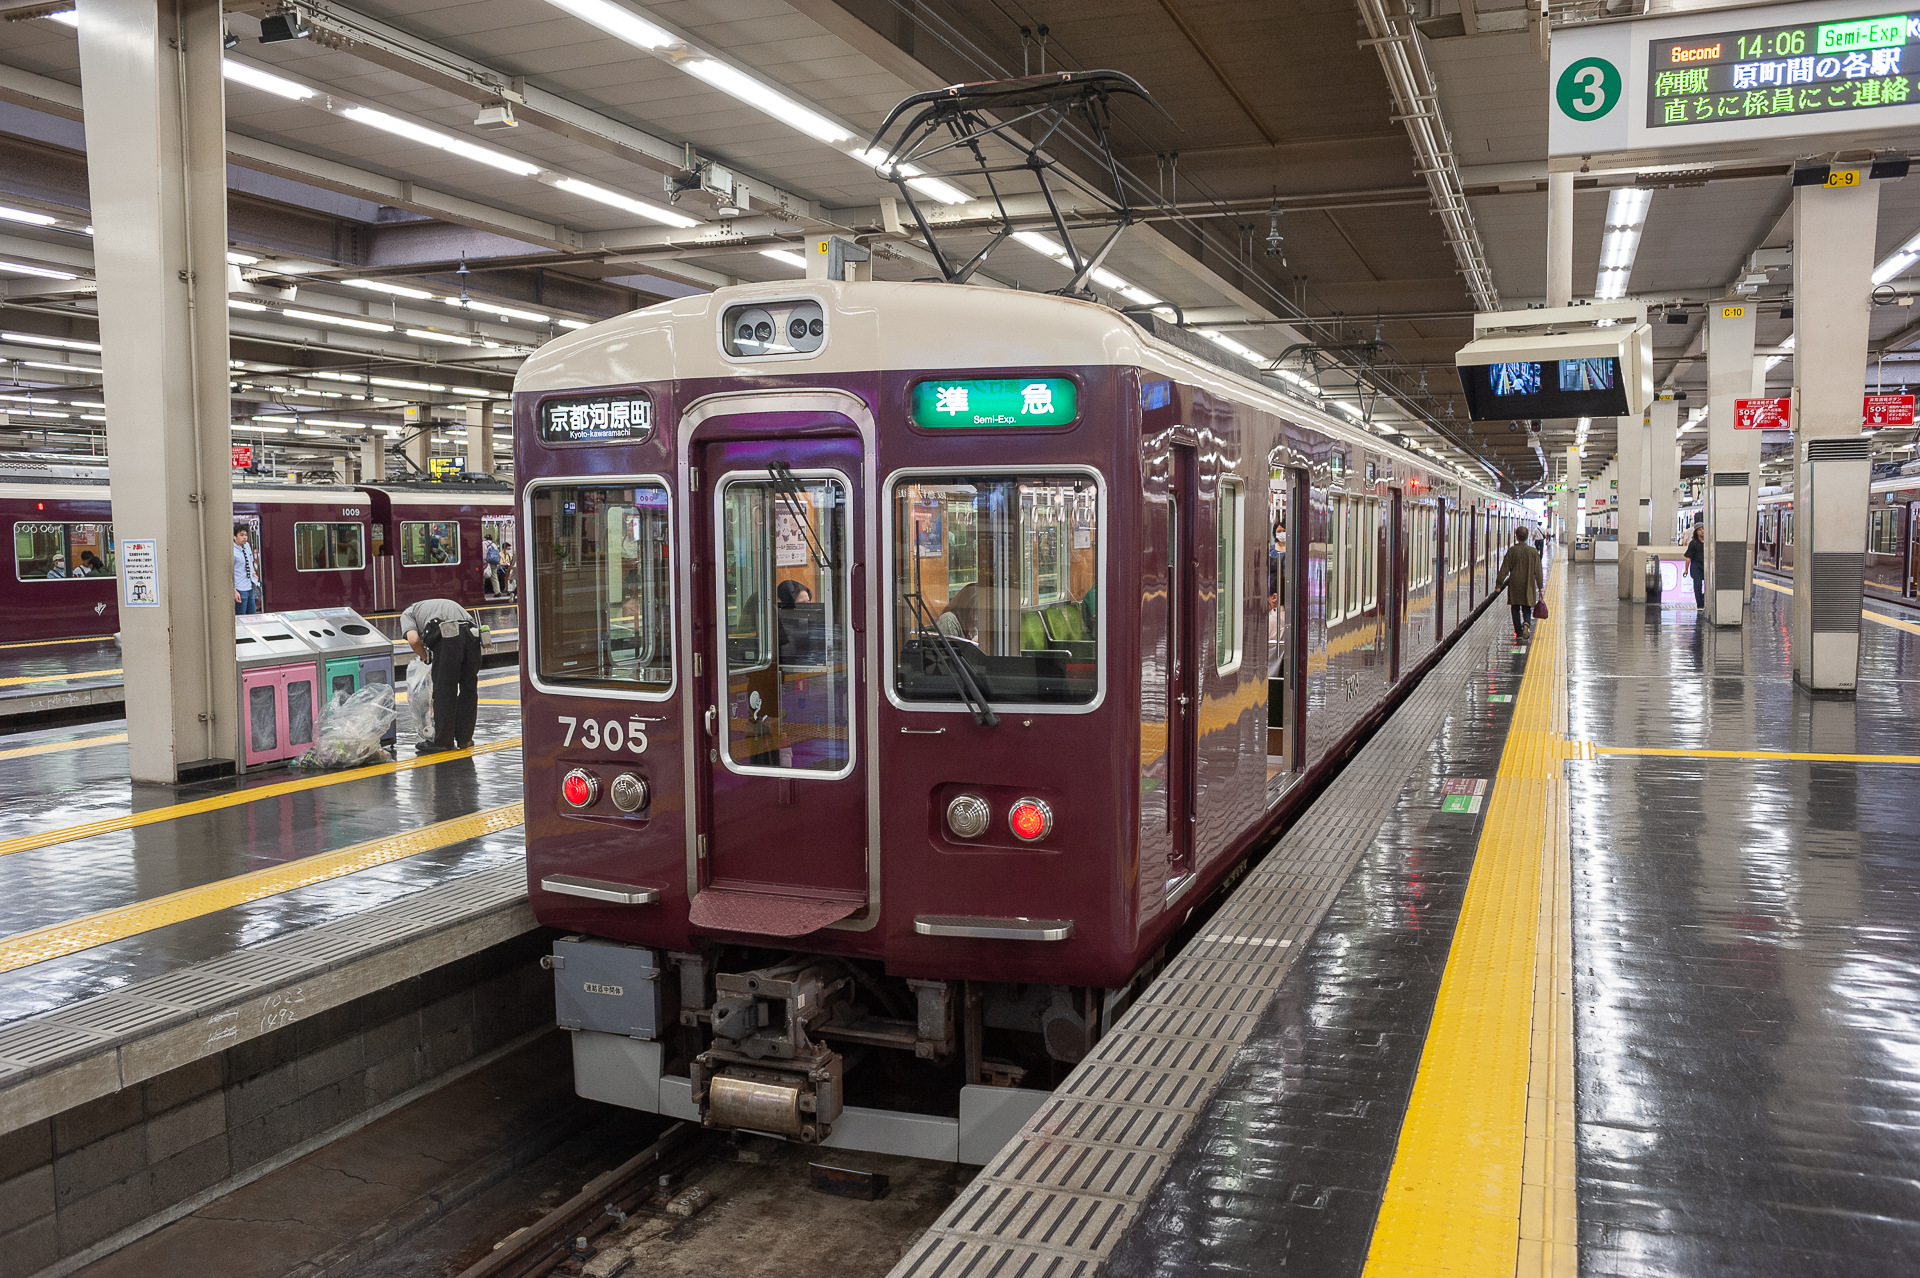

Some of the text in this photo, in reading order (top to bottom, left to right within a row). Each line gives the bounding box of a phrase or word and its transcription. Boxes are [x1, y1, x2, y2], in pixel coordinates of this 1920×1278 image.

[1671, 44, 1721, 62] Second
[1737, 30, 1805, 59] 14:06
[1825, 24, 1902, 47] Semi-Exp.
[1655, 47, 1902, 98] 停車駅 原町間の各駅
[1572, 66, 1606, 114] 3
[1664, 76, 1910, 124] 直ちに係員にご連絡
[1829, 172, 1854, 186] C-9
[1724, 308, 1742, 317] C-10
[549, 400, 652, 432] 京都河原町
[973, 415, 1017, 425] Semi-Exp.
[569, 429, 631, 440] Kyoto-kawaramachi
[342, 508, 360, 516] 1009
[558, 715, 648, 754] 7305
